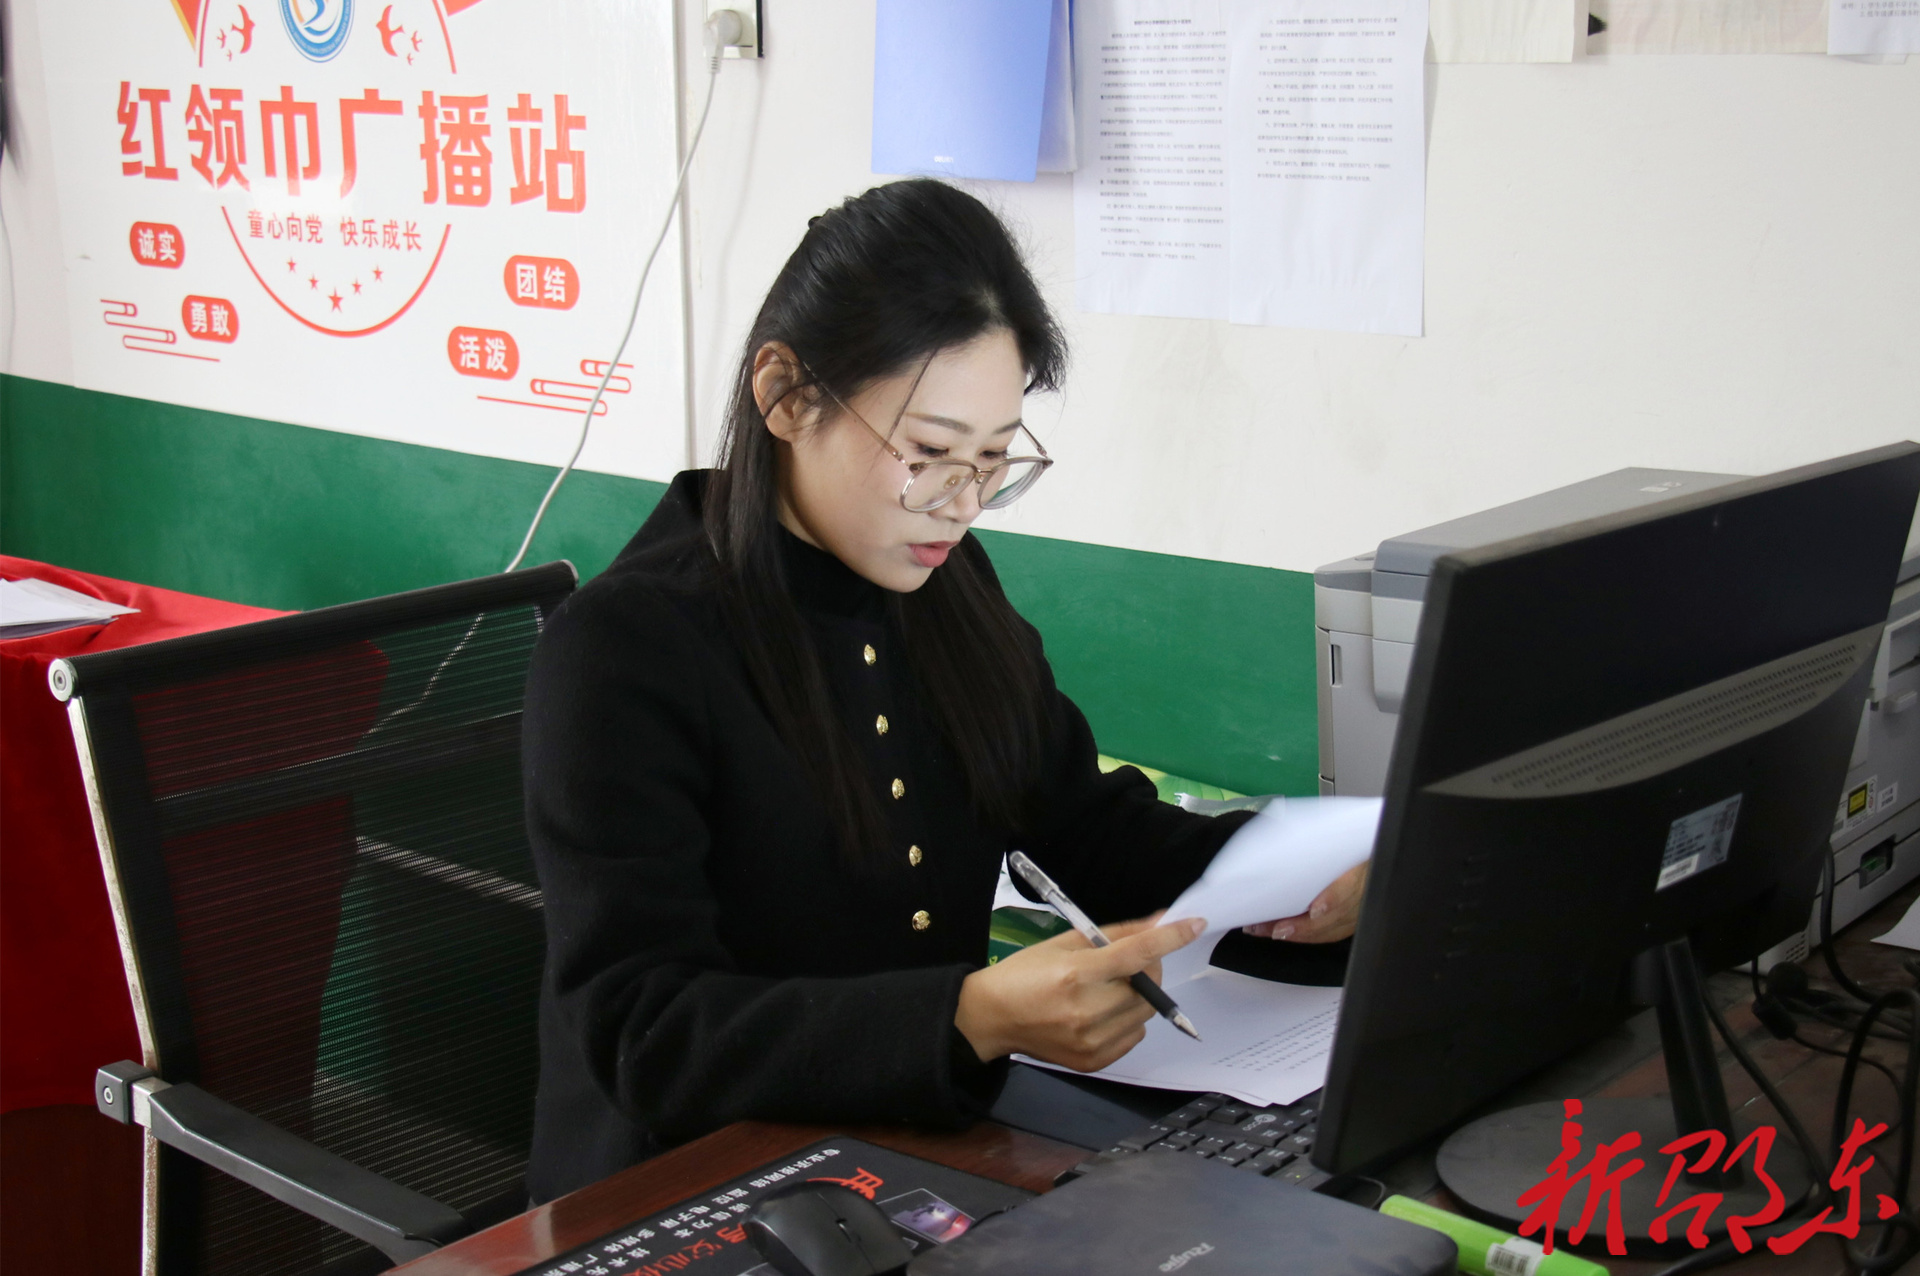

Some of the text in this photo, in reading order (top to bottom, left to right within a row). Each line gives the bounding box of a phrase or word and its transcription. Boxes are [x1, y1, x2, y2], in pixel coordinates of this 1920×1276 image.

[117, 81, 586, 213] 红领巾广播站
[138, 228, 177, 262] 诚实
[248, 209, 422, 251] 童心向党 快乐成长
[516, 263, 566, 302] 团结
[191, 302, 231, 336] 勇敢
[459, 334, 508, 373] 活泼
[750, 1148, 840, 1188] 专业承接网络
[712, 1188, 749, 1205] 监控
[674, 1202, 751, 1239] 诚信为本
[603, 1228, 656, 1253] 多媒体
